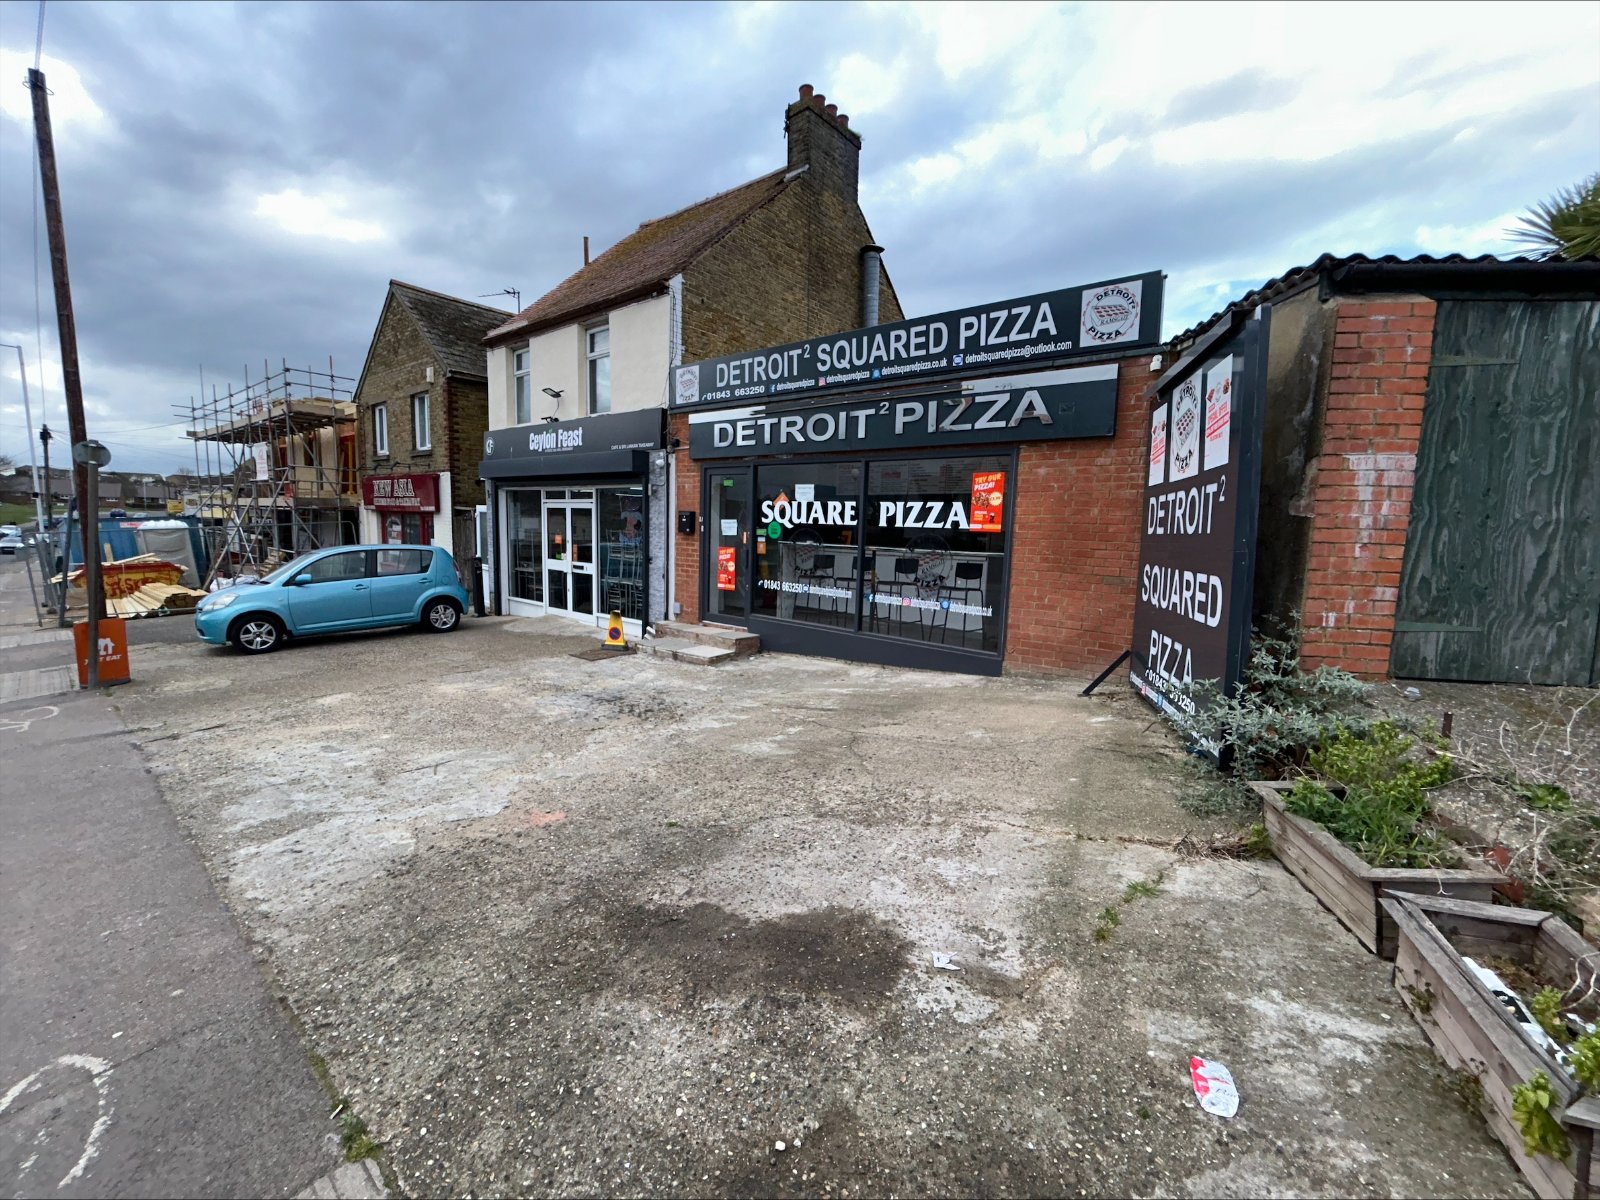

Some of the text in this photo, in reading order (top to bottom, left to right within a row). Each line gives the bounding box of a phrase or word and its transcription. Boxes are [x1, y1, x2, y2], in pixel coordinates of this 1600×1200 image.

[816, 322, 949, 372] SQUARED
[959, 302, 1058, 350] PIZZA
[1088, 326, 1122, 340] PIZZA
[706, 390, 731, 401] 01843
[734, 385, 765, 397] 663250
[881, 357, 948, 377] detroitsquaredpizza.co.uk
[965, 340, 1072, 363] detroitsquaredpizza@outlook.com
[895, 390, 1053, 435] PIZZA
[529, 426, 583, 452] Ceylon Feast
[372, 478, 415, 497] NEW ASIA
[975, 473, 1002, 484] TRY OUR
[761, 500, 858, 528] SQUARE
[879, 501, 970, 529] PIZZA
[763, 579, 781, 591] 01843
[781, 582, 802, 593] 663250
[1141, 563, 1223, 628] SQUARED
[1148, 629, 1193, 697] PIZZA
